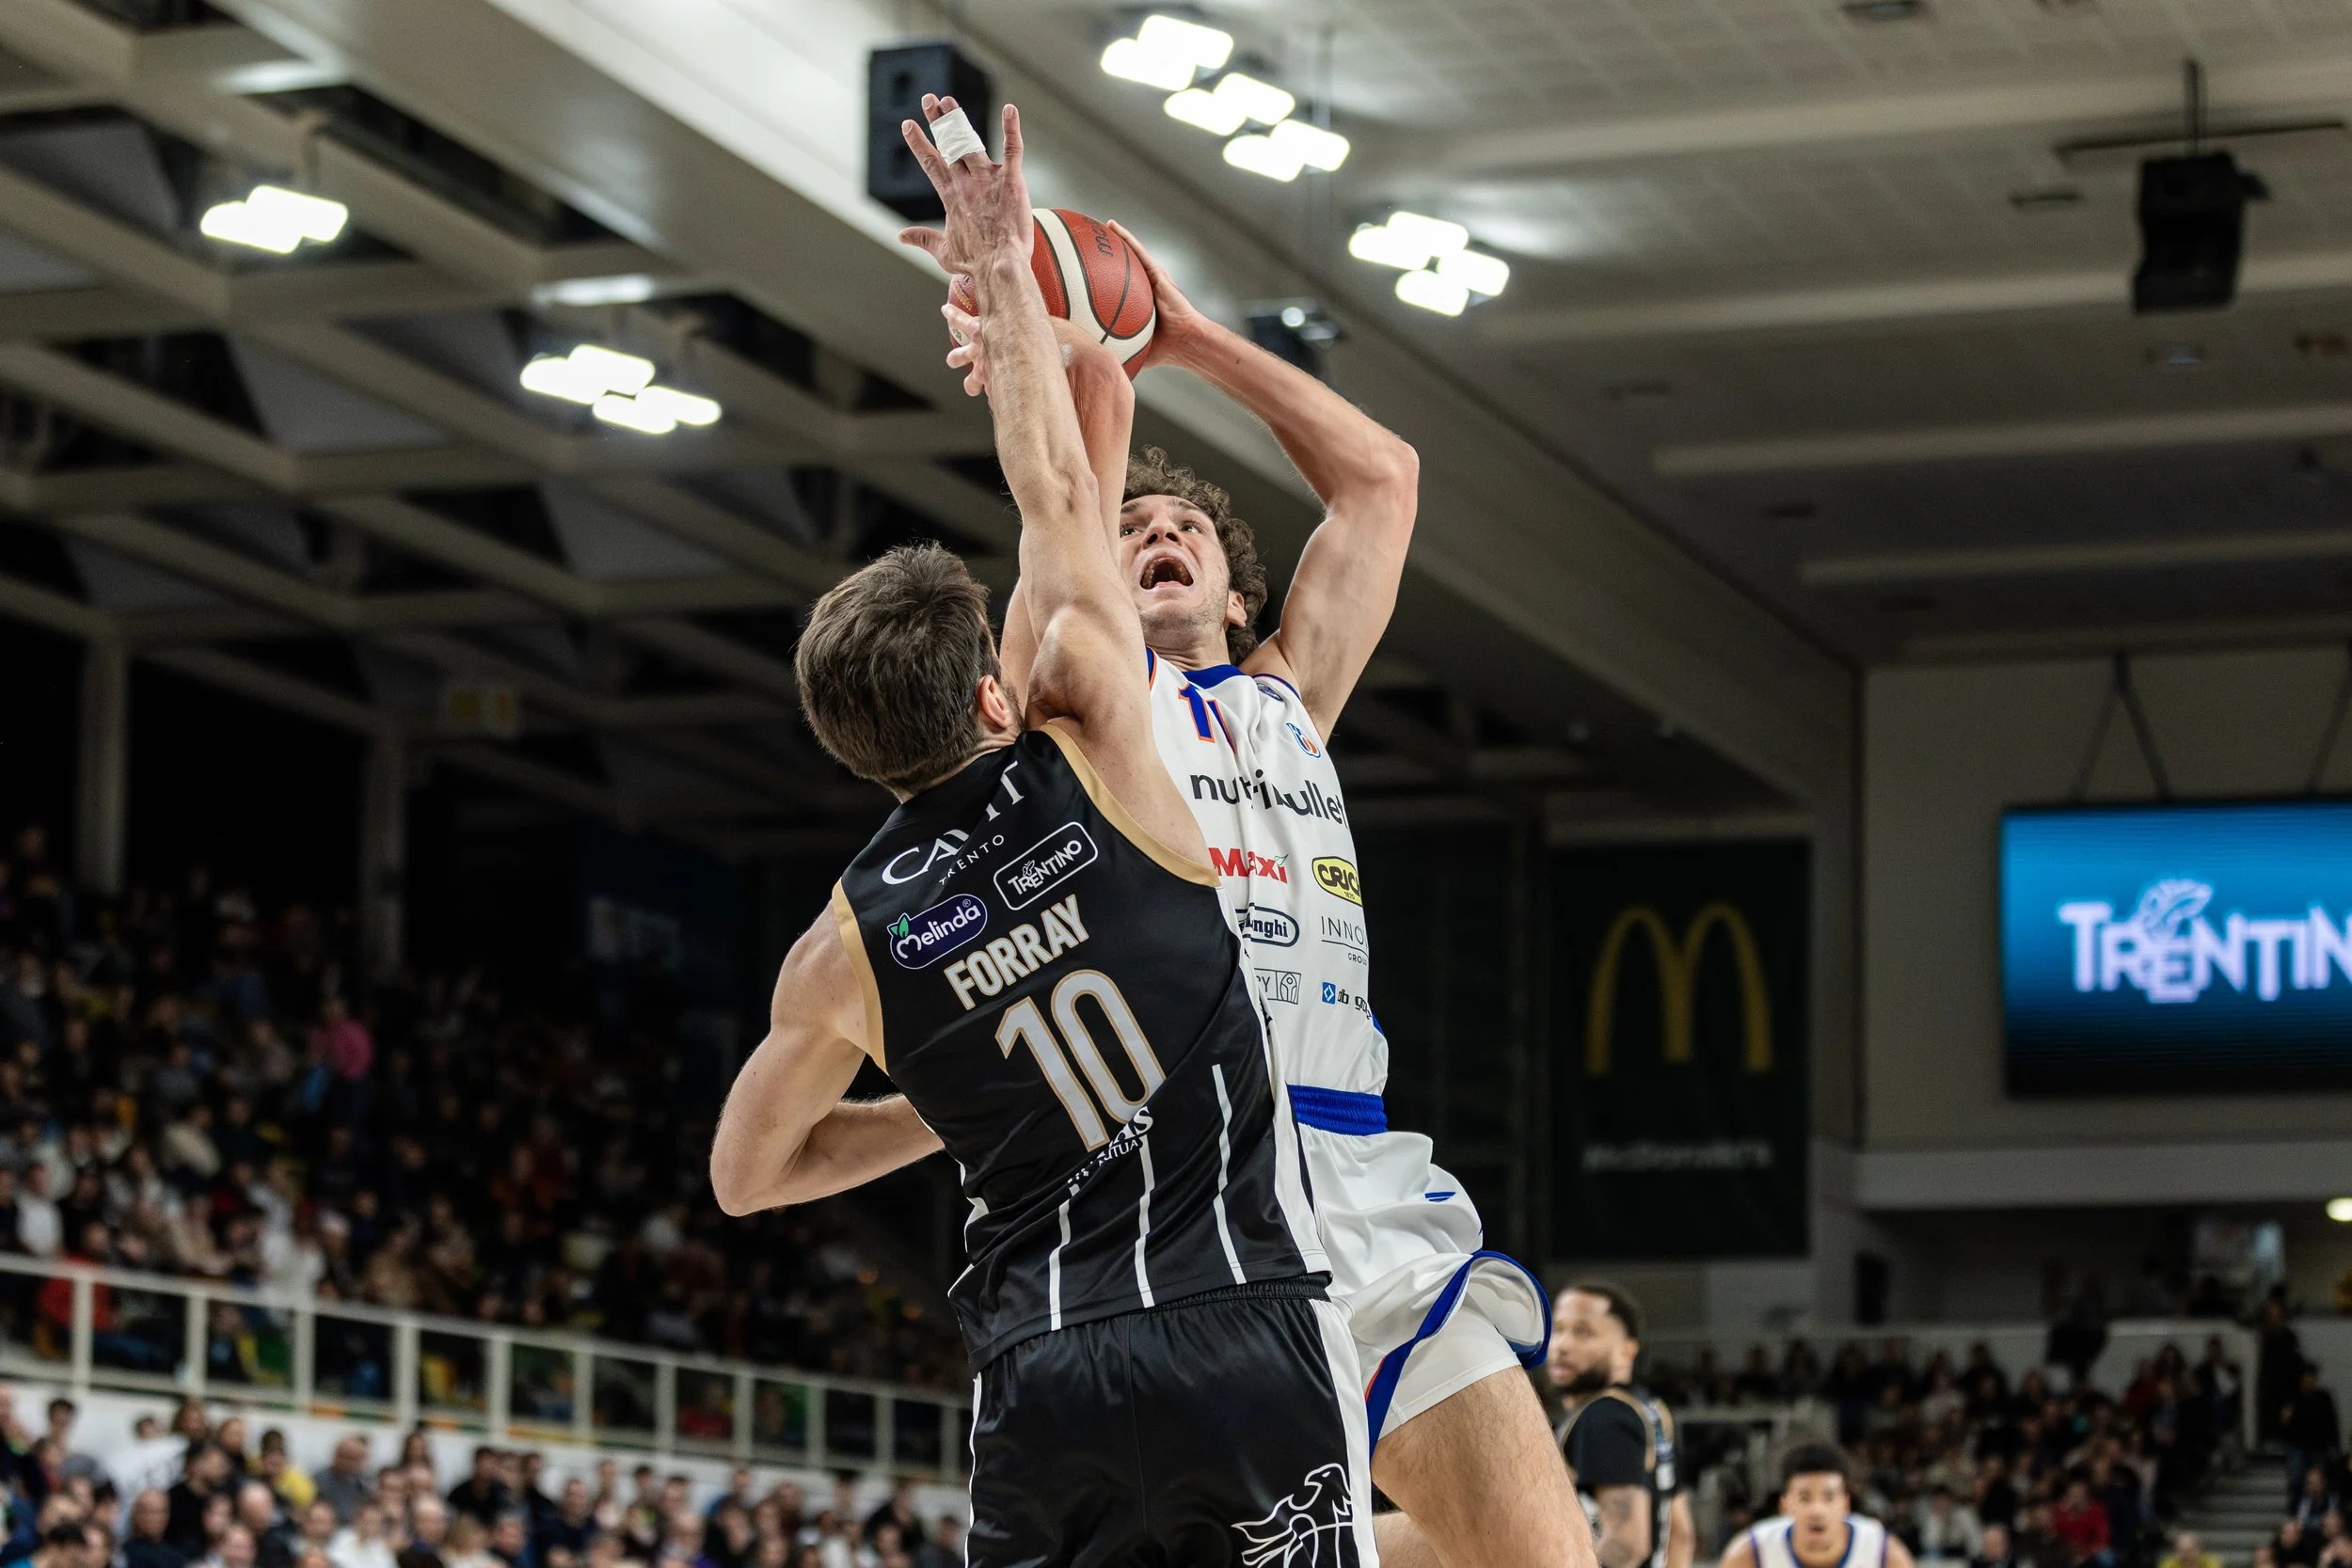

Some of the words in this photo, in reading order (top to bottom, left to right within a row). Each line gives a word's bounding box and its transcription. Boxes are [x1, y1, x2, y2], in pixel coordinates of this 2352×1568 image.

[1008, 839, 1082, 895] TRENTINO
[1317, 863, 1360, 896] CRIC
[897, 903, 981, 959] Melinda
[944, 895, 1089, 1010] FORRAY
[1321, 916, 1368, 946] INNO
[994, 969, 1167, 1152] 10
